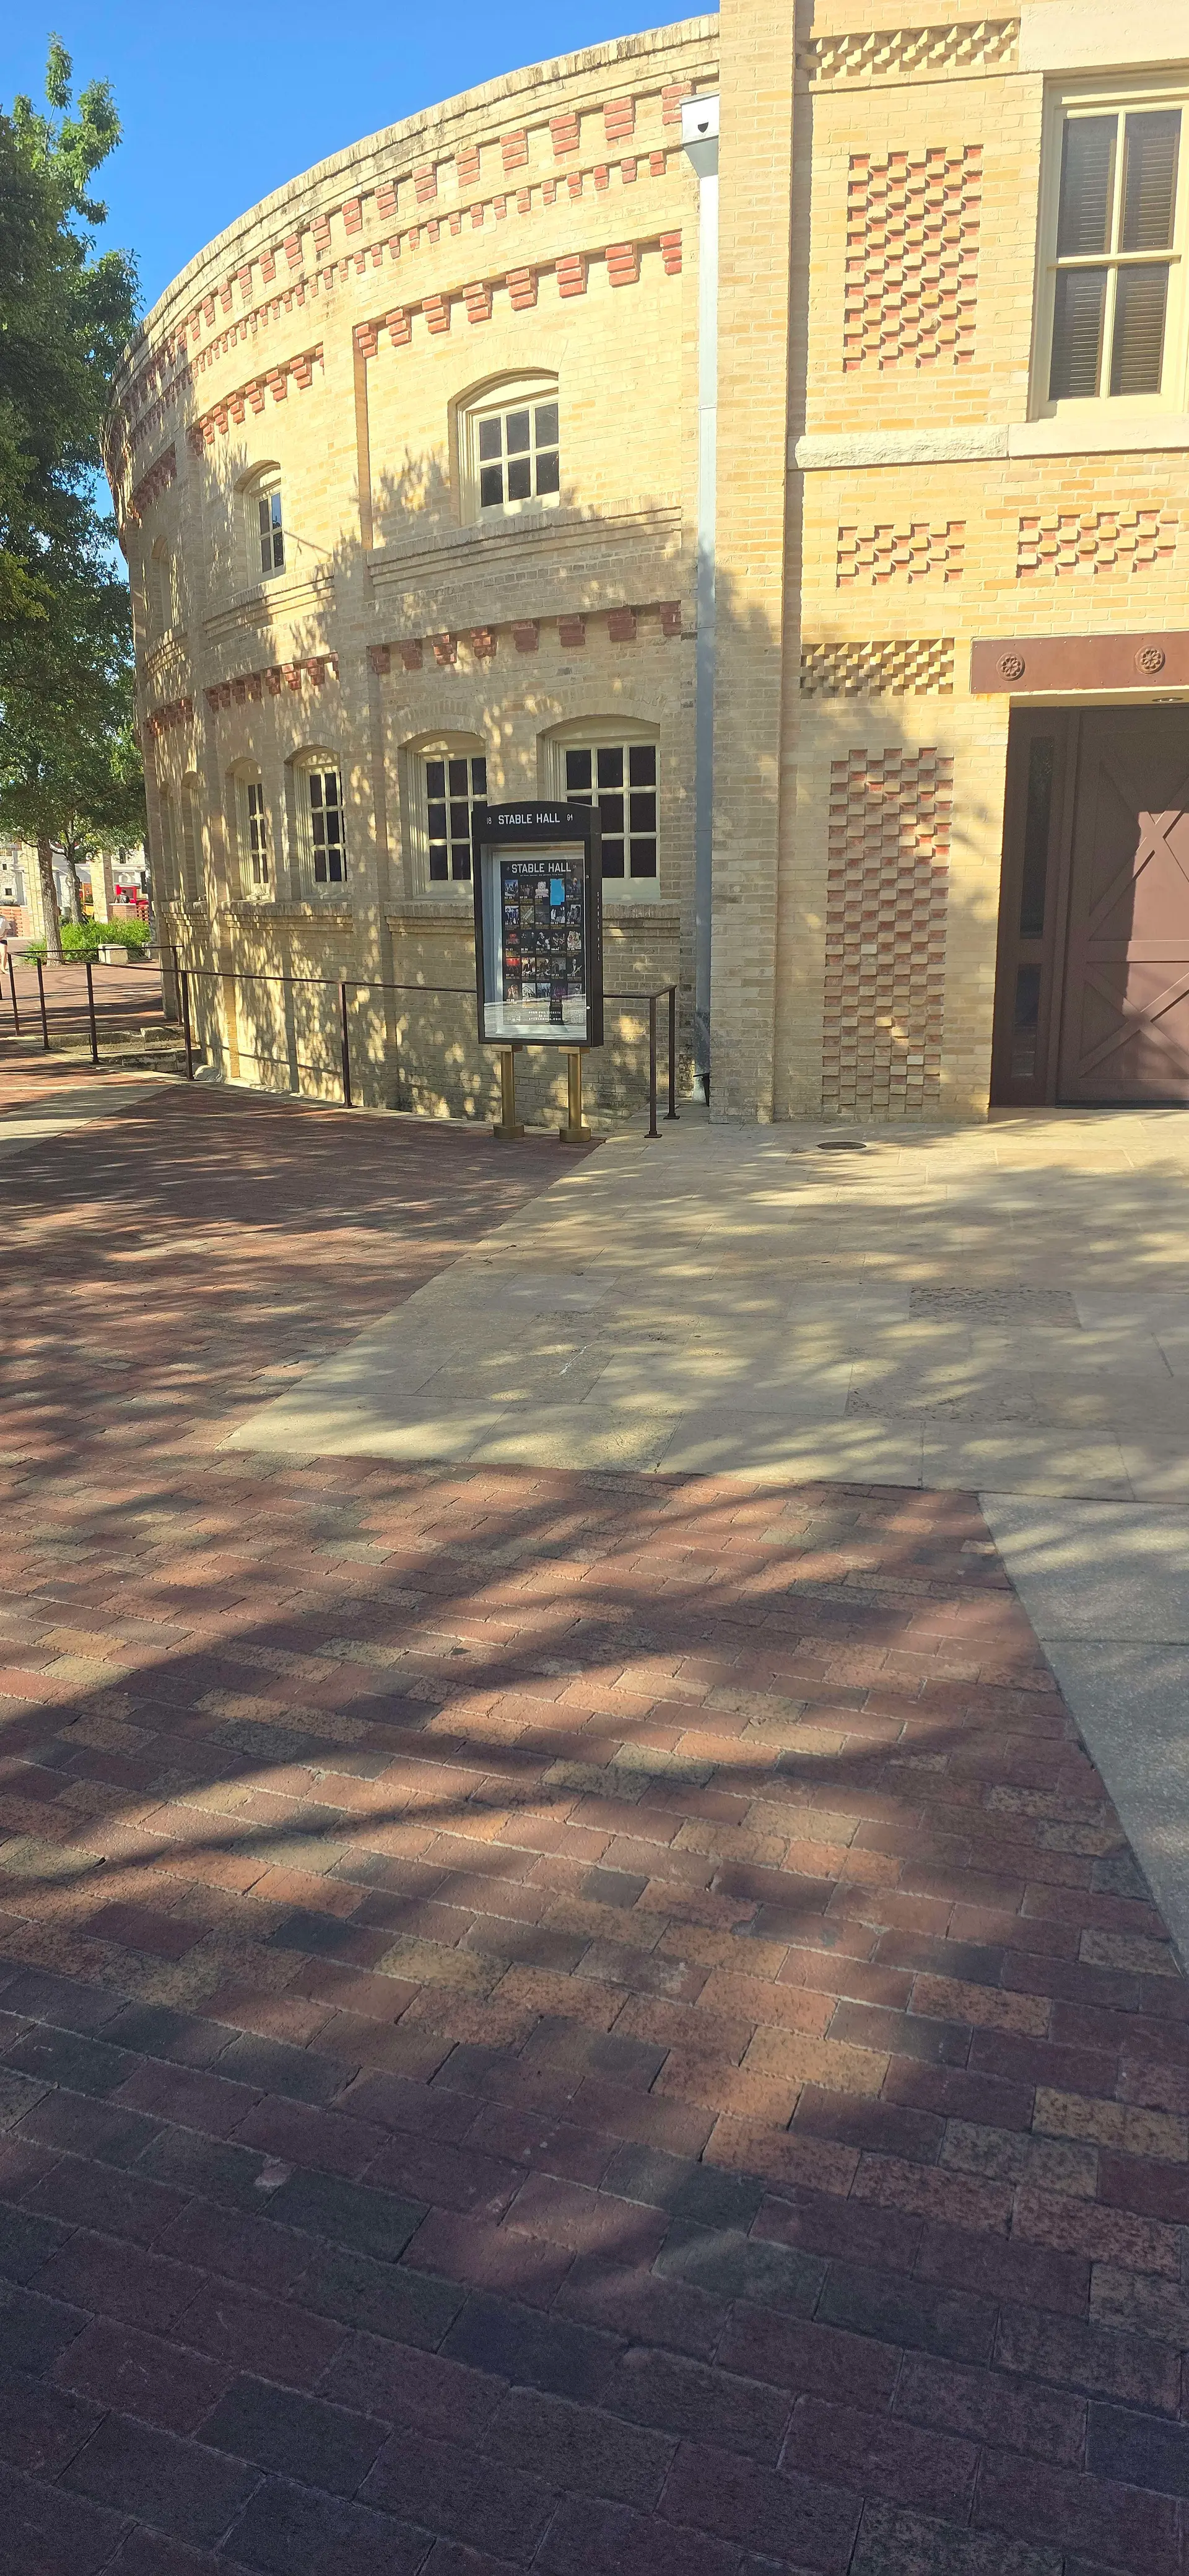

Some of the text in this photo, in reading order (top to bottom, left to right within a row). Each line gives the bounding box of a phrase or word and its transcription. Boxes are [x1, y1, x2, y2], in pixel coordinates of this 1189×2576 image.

[486, 817, 492, 825] 18
[498, 813, 533, 825] STABLE
[536, 813, 560, 823] HALL
[512, 863, 545, 874] STABLE
[548, 862, 572, 872] HALL
